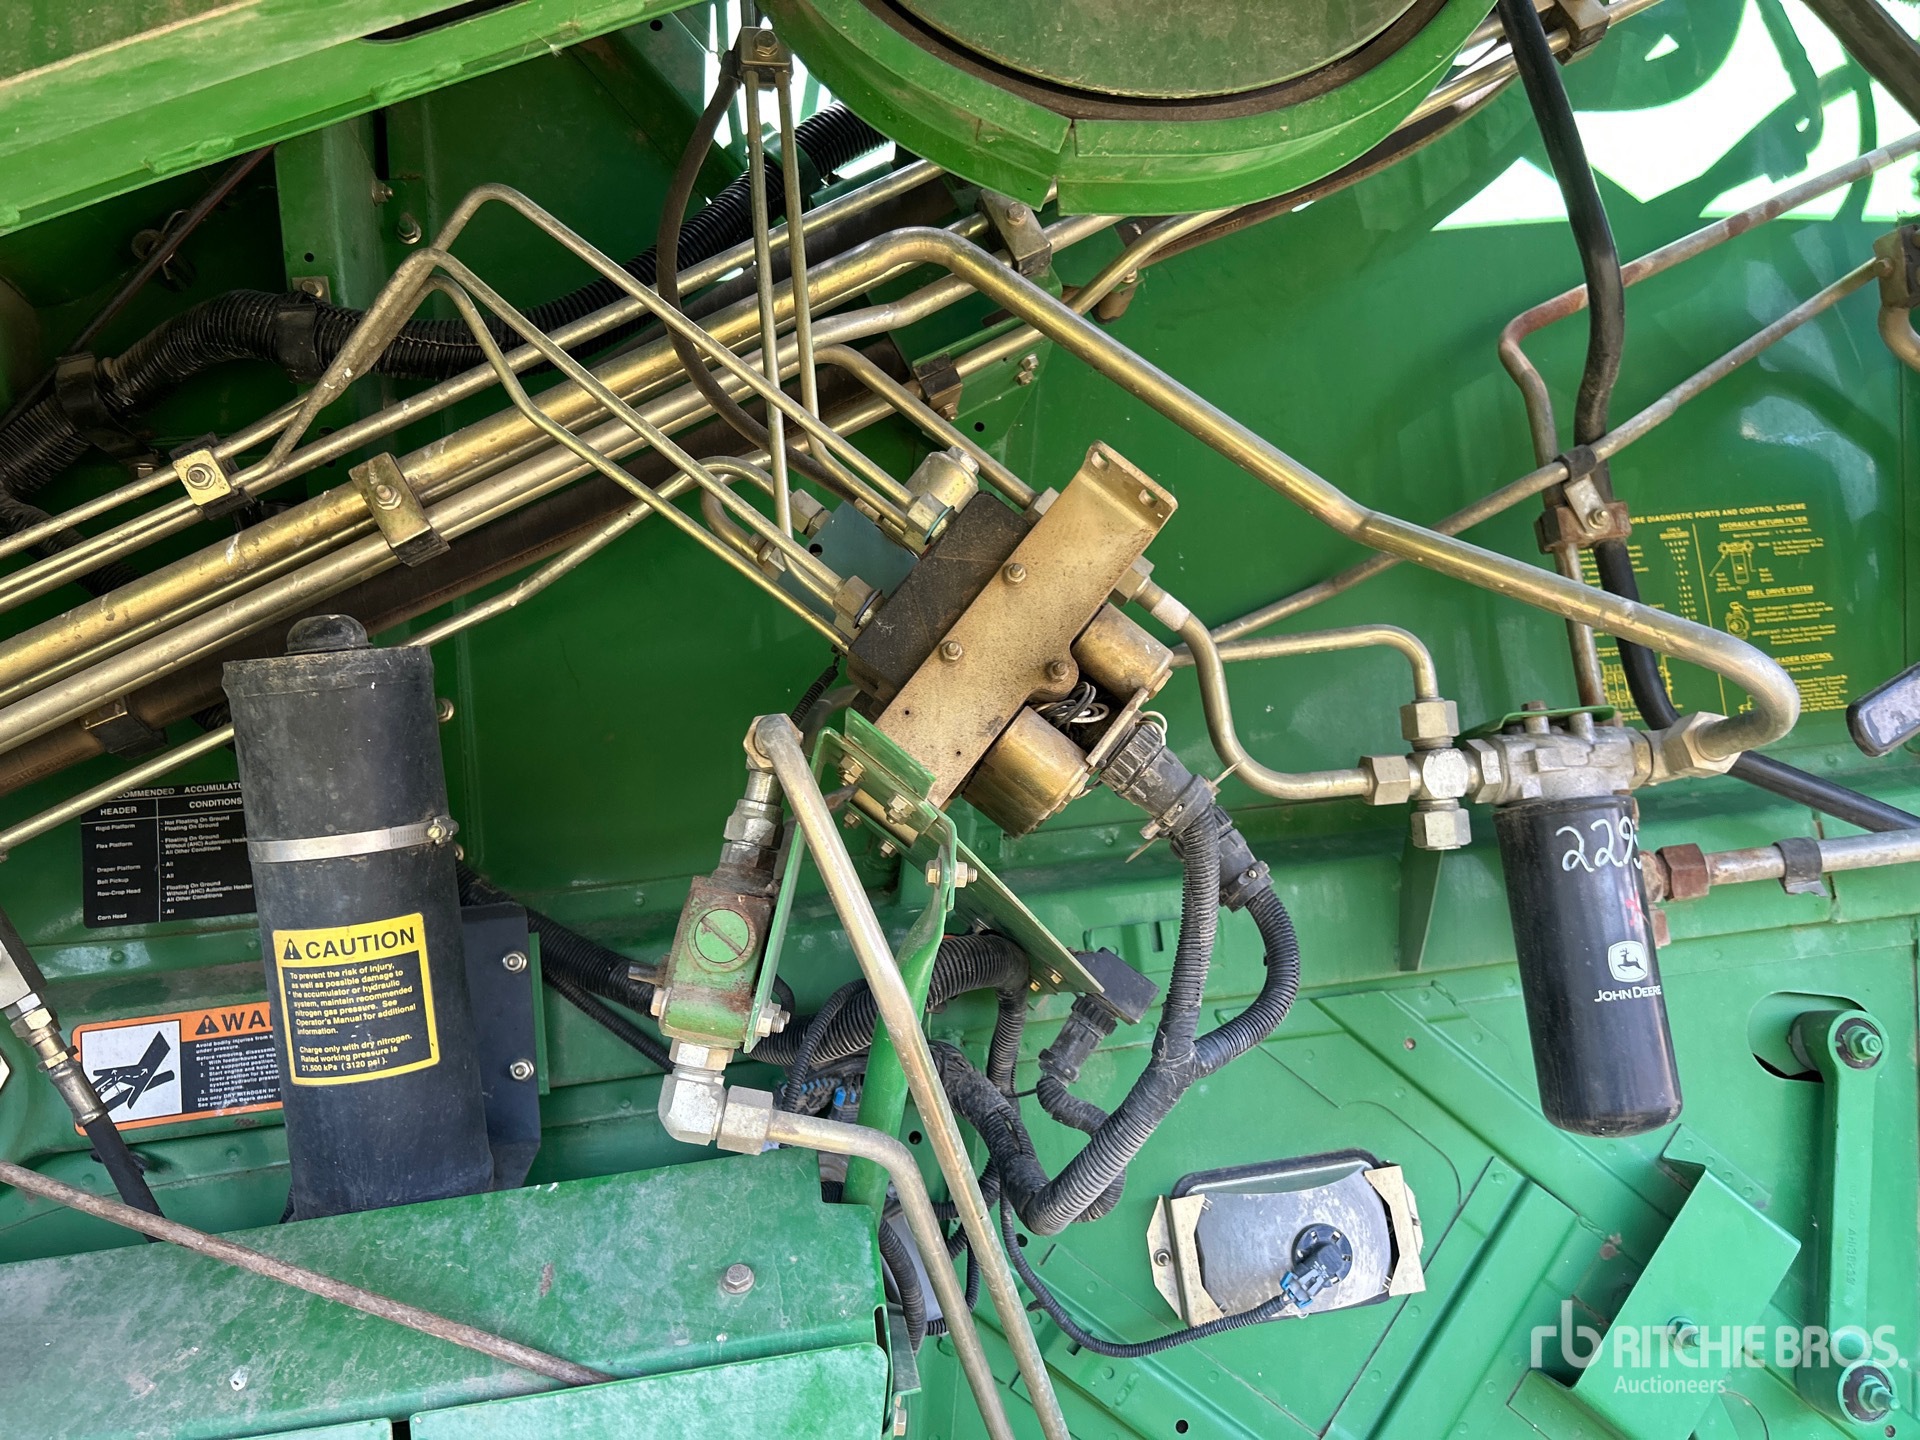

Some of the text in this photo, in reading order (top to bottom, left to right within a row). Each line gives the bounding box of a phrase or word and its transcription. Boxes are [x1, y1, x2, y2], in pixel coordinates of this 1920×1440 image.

[1647, 512, 1693, 523] DIAGNOSTIC
[1694, 510, 1720, 518] PORTS
[1740, 506, 1775, 514] CONTROL
[1776, 503, 1806, 511] SCHEME
[1787, 585, 1814, 593] SYSTEM
[1801, 653, 1832, 661] CONTROL
[117, 788, 175, 798] OMMENDED
[189, 797, 242, 808] CONDITIONS
[100, 806, 137, 816] HEADER
[191, 845, 221, 853] Conditions
[166, 883, 189, 891] Floating
[206, 885, 232, 893] Automatic
[192, 892, 222, 900] Conditions
[306, 927, 414, 958] CAUTION
[299, 971, 325, 980] prevent
[327, 970, 339, 978] the
[342, 968, 358, 976] risk
[359, 965, 369, 973] of
[370, 962, 394, 973] injury,
[299, 981, 314, 989] well
[326, 977, 359, 988] possible
[361, 972, 393, 984] damage
[303, 988, 350, 998] accumulator
[362, 980, 400, 993] hydraulic
[1594, 985, 1661, 1002] JOHN DEERE
[321, 997, 354, 1007] maintain
[356, 986, 412, 1003] recommended
[295, 1000, 397, 1018] nitrogen gas pressure. See
[296, 1003, 416, 1027] Operator's Manual for additional
[221, 1010, 272, 1031] WA
[214, 1045, 240, 1053] pressure.
[300, 1034, 412, 1054] Charge only with dry nitrogen.
[301, 1055, 319, 1063] Rated
[320, 1053, 351, 1062] working
[352, 1048, 389, 1061] pressure
[302, 1059, 381, 1072] 21,500 kPa 3120 psi
[237, 1089, 266, 1097] NITROGEN
